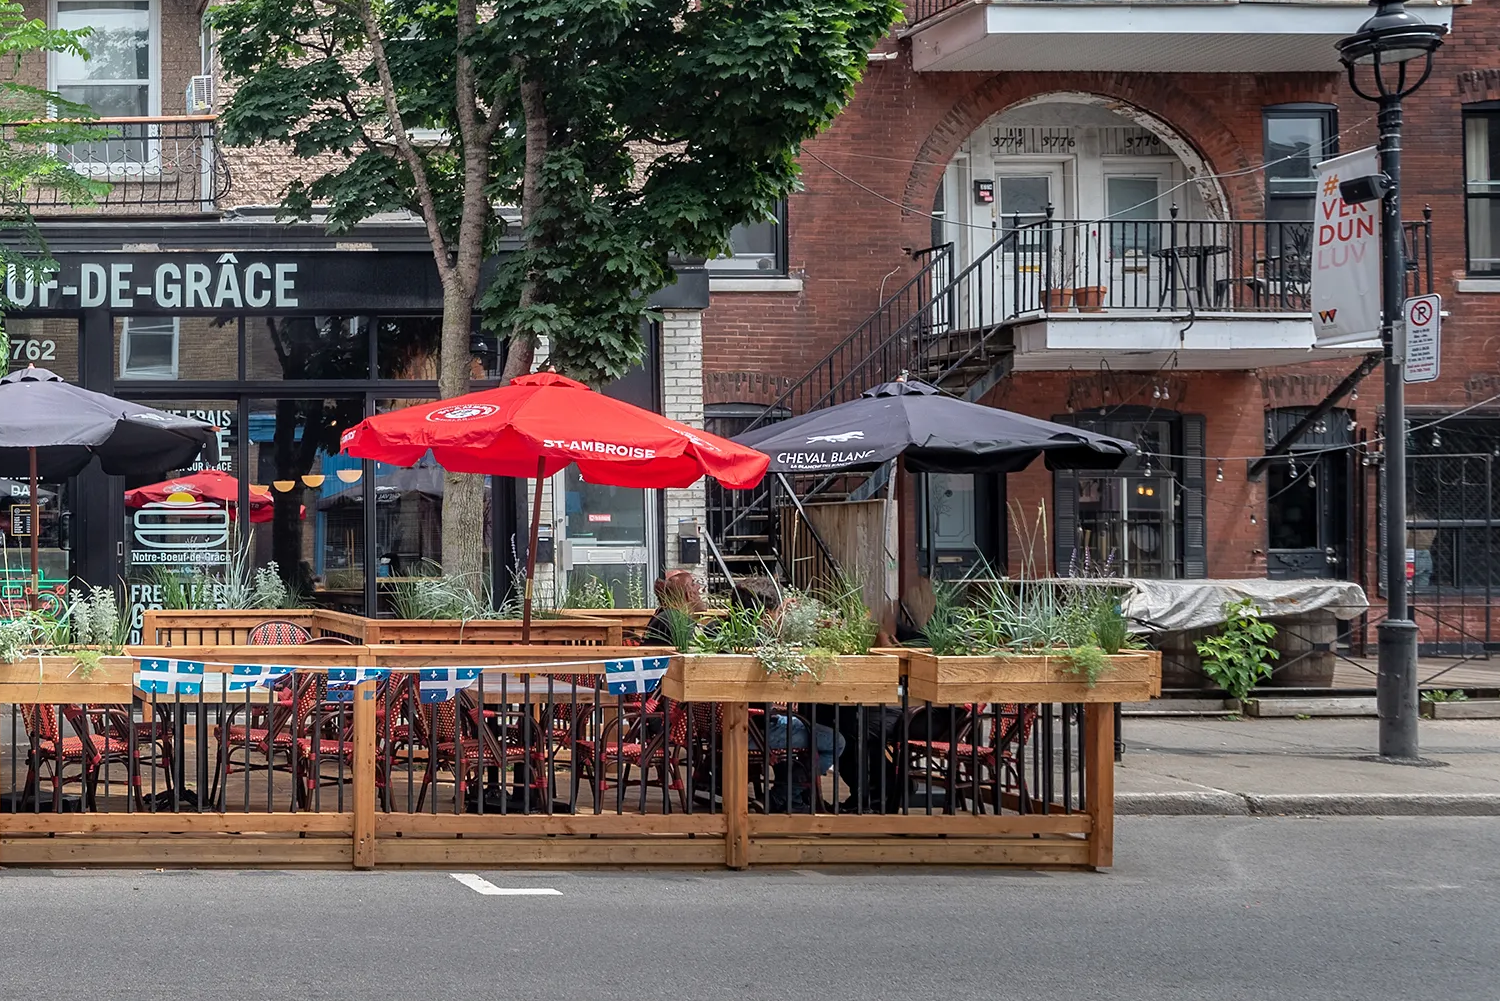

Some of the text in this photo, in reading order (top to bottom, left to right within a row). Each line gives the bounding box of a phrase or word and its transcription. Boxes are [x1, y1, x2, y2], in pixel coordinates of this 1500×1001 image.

[992, 136, 1024, 148] 3774
[1041, 136, 1076, 147] 3776
[1319, 214, 1374, 247] DUN
[1317, 244, 1367, 271] LUV
[5, 339, 56, 360] 762
[543, 439, 656, 459] ST-AMBROISE
[777, 452, 827, 464] CHEVAL
[132, 551, 231, 562] Notre-Boeuf-de-Grâce
[131, 584, 186, 603] FRE
